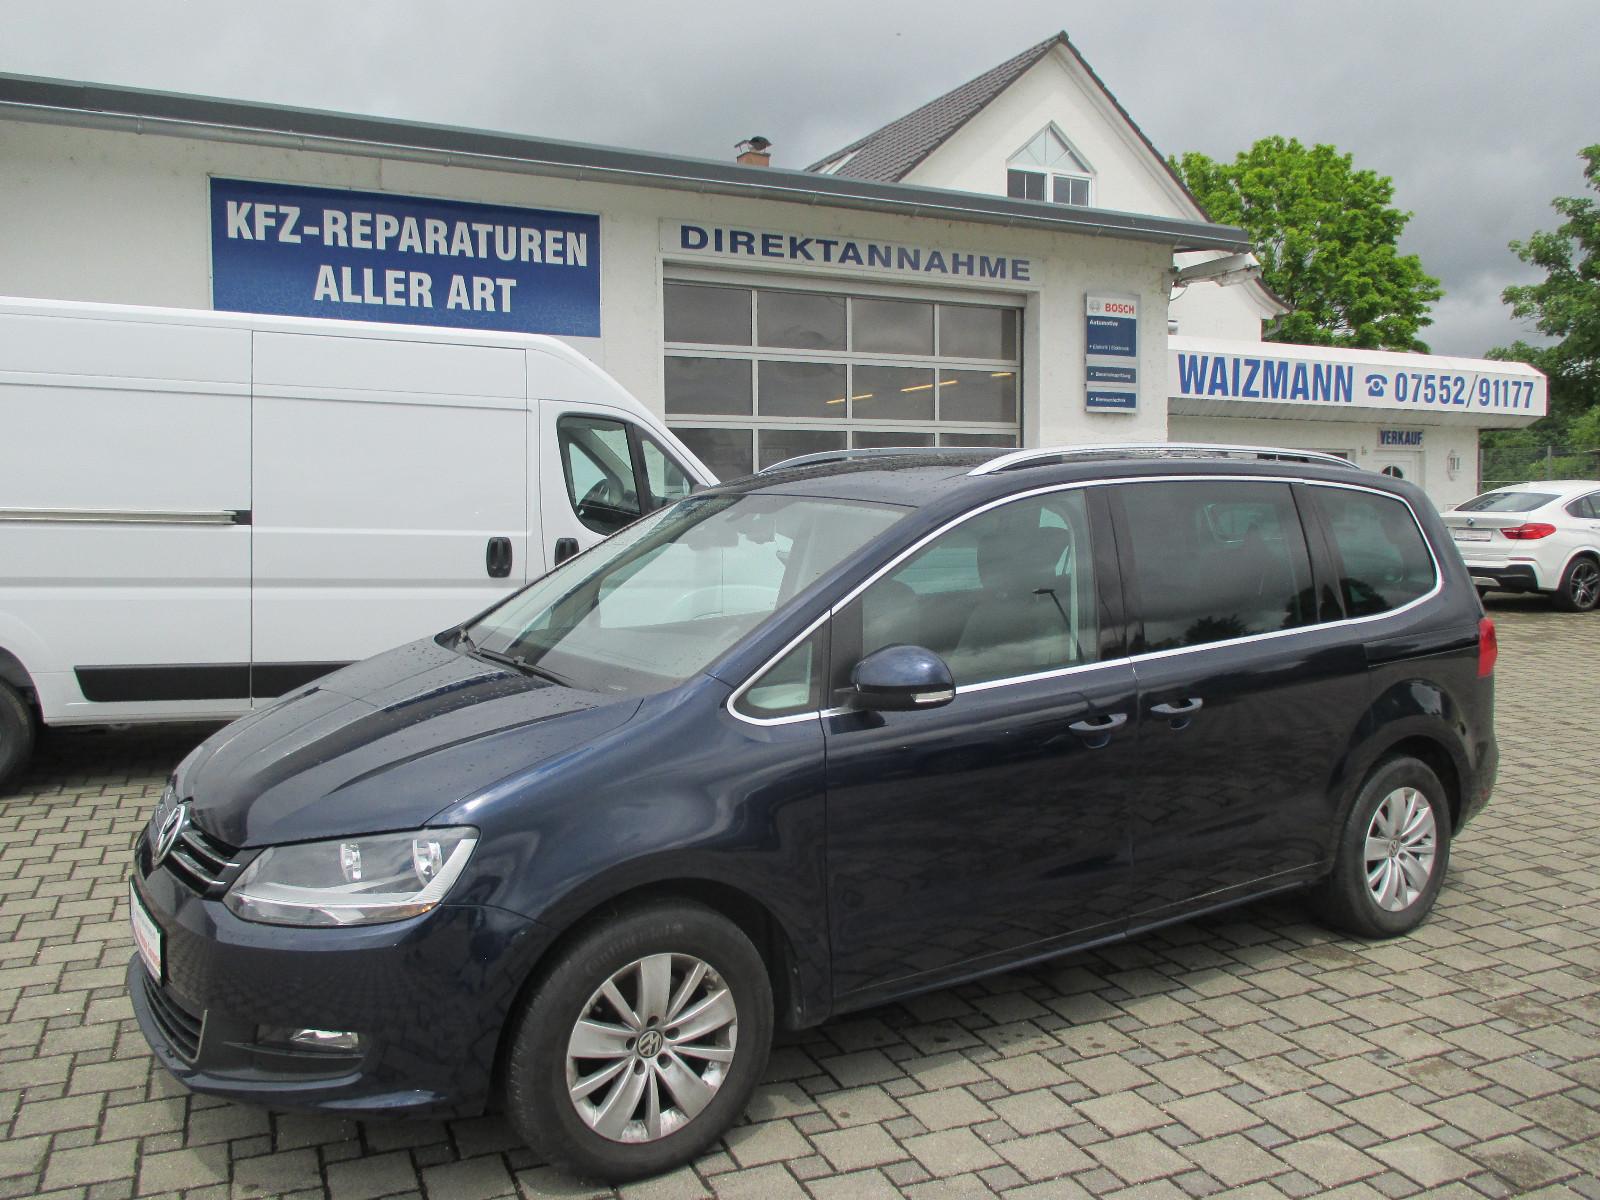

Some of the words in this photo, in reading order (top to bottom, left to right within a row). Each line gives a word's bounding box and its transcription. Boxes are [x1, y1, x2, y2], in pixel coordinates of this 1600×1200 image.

[226, 201, 587, 267] KFZ-REPARATUREN
[680, 224, 1031, 281] DIREKTANNAHME
[314, 265, 433, 308] ALLER
[446, 275, 517, 312] ART
[1104, 303, 1135, 314] BOSCH
[1178, 353, 1354, 402] WAIZMANN
[1394, 373, 1534, 409] 07552/91177
[1380, 430, 1423, 445] VERKAUF
